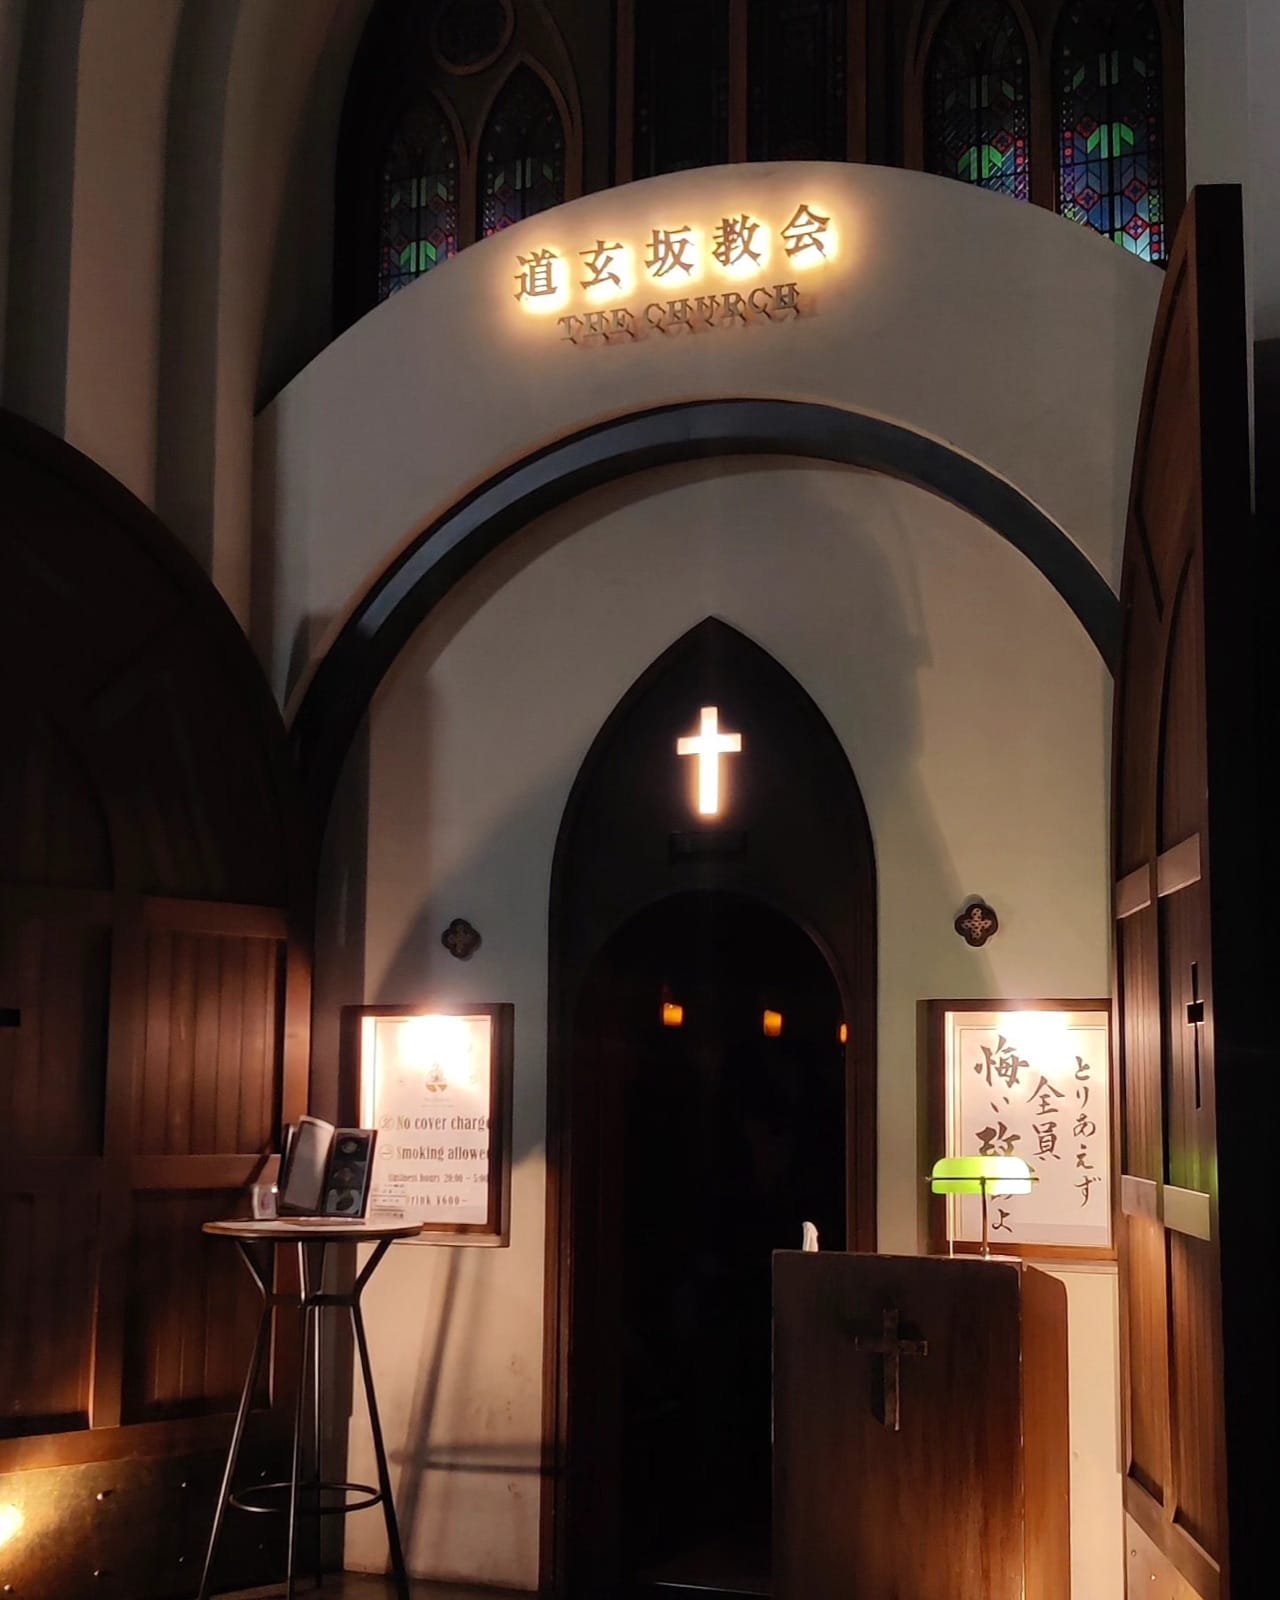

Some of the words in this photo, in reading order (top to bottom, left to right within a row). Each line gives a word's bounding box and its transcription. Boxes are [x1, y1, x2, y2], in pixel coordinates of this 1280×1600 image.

[513, 203, 831, 302] 道玄坂教会
[557, 308, 633, 340] THE
[642, 283, 800, 328] CHURCH
[396, 1146, 445, 1161] Smoking
[397, 1115, 411, 1130] No
[414, 1116, 447, 1130] cover
[973, 1034, 1036, 1233] 悔い改よ
[1026, 1075, 1066, 1161] 全員
[1072, 1055, 1102, 1208] とりあえず
